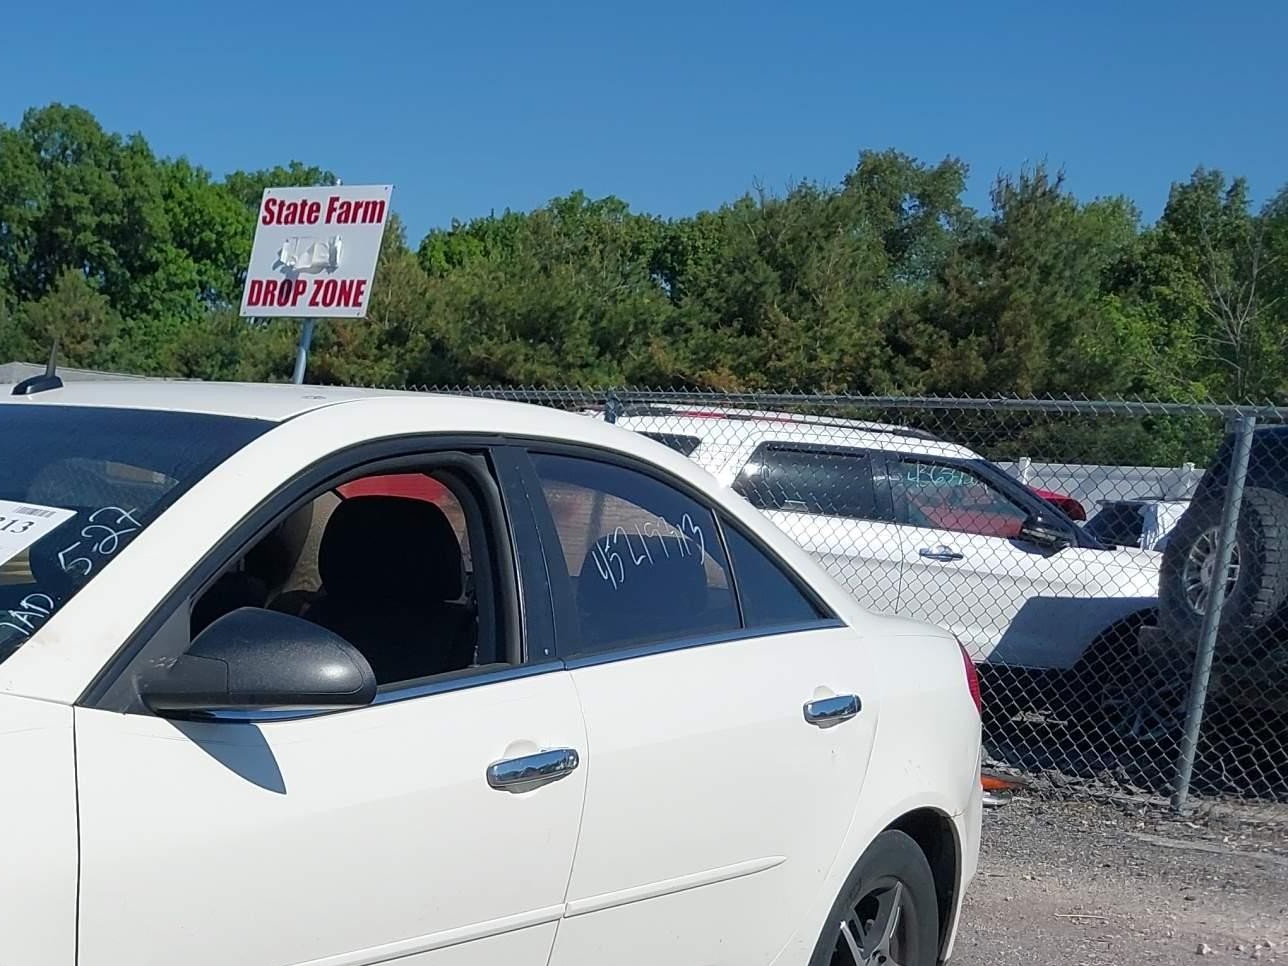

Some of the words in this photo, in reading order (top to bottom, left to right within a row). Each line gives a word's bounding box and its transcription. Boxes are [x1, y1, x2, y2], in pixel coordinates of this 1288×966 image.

[261, 197, 322, 225] State
[325, 196, 386, 225] Farm
[247, 279, 307, 308] DROP
[309, 279, 368, 308] ZONE
